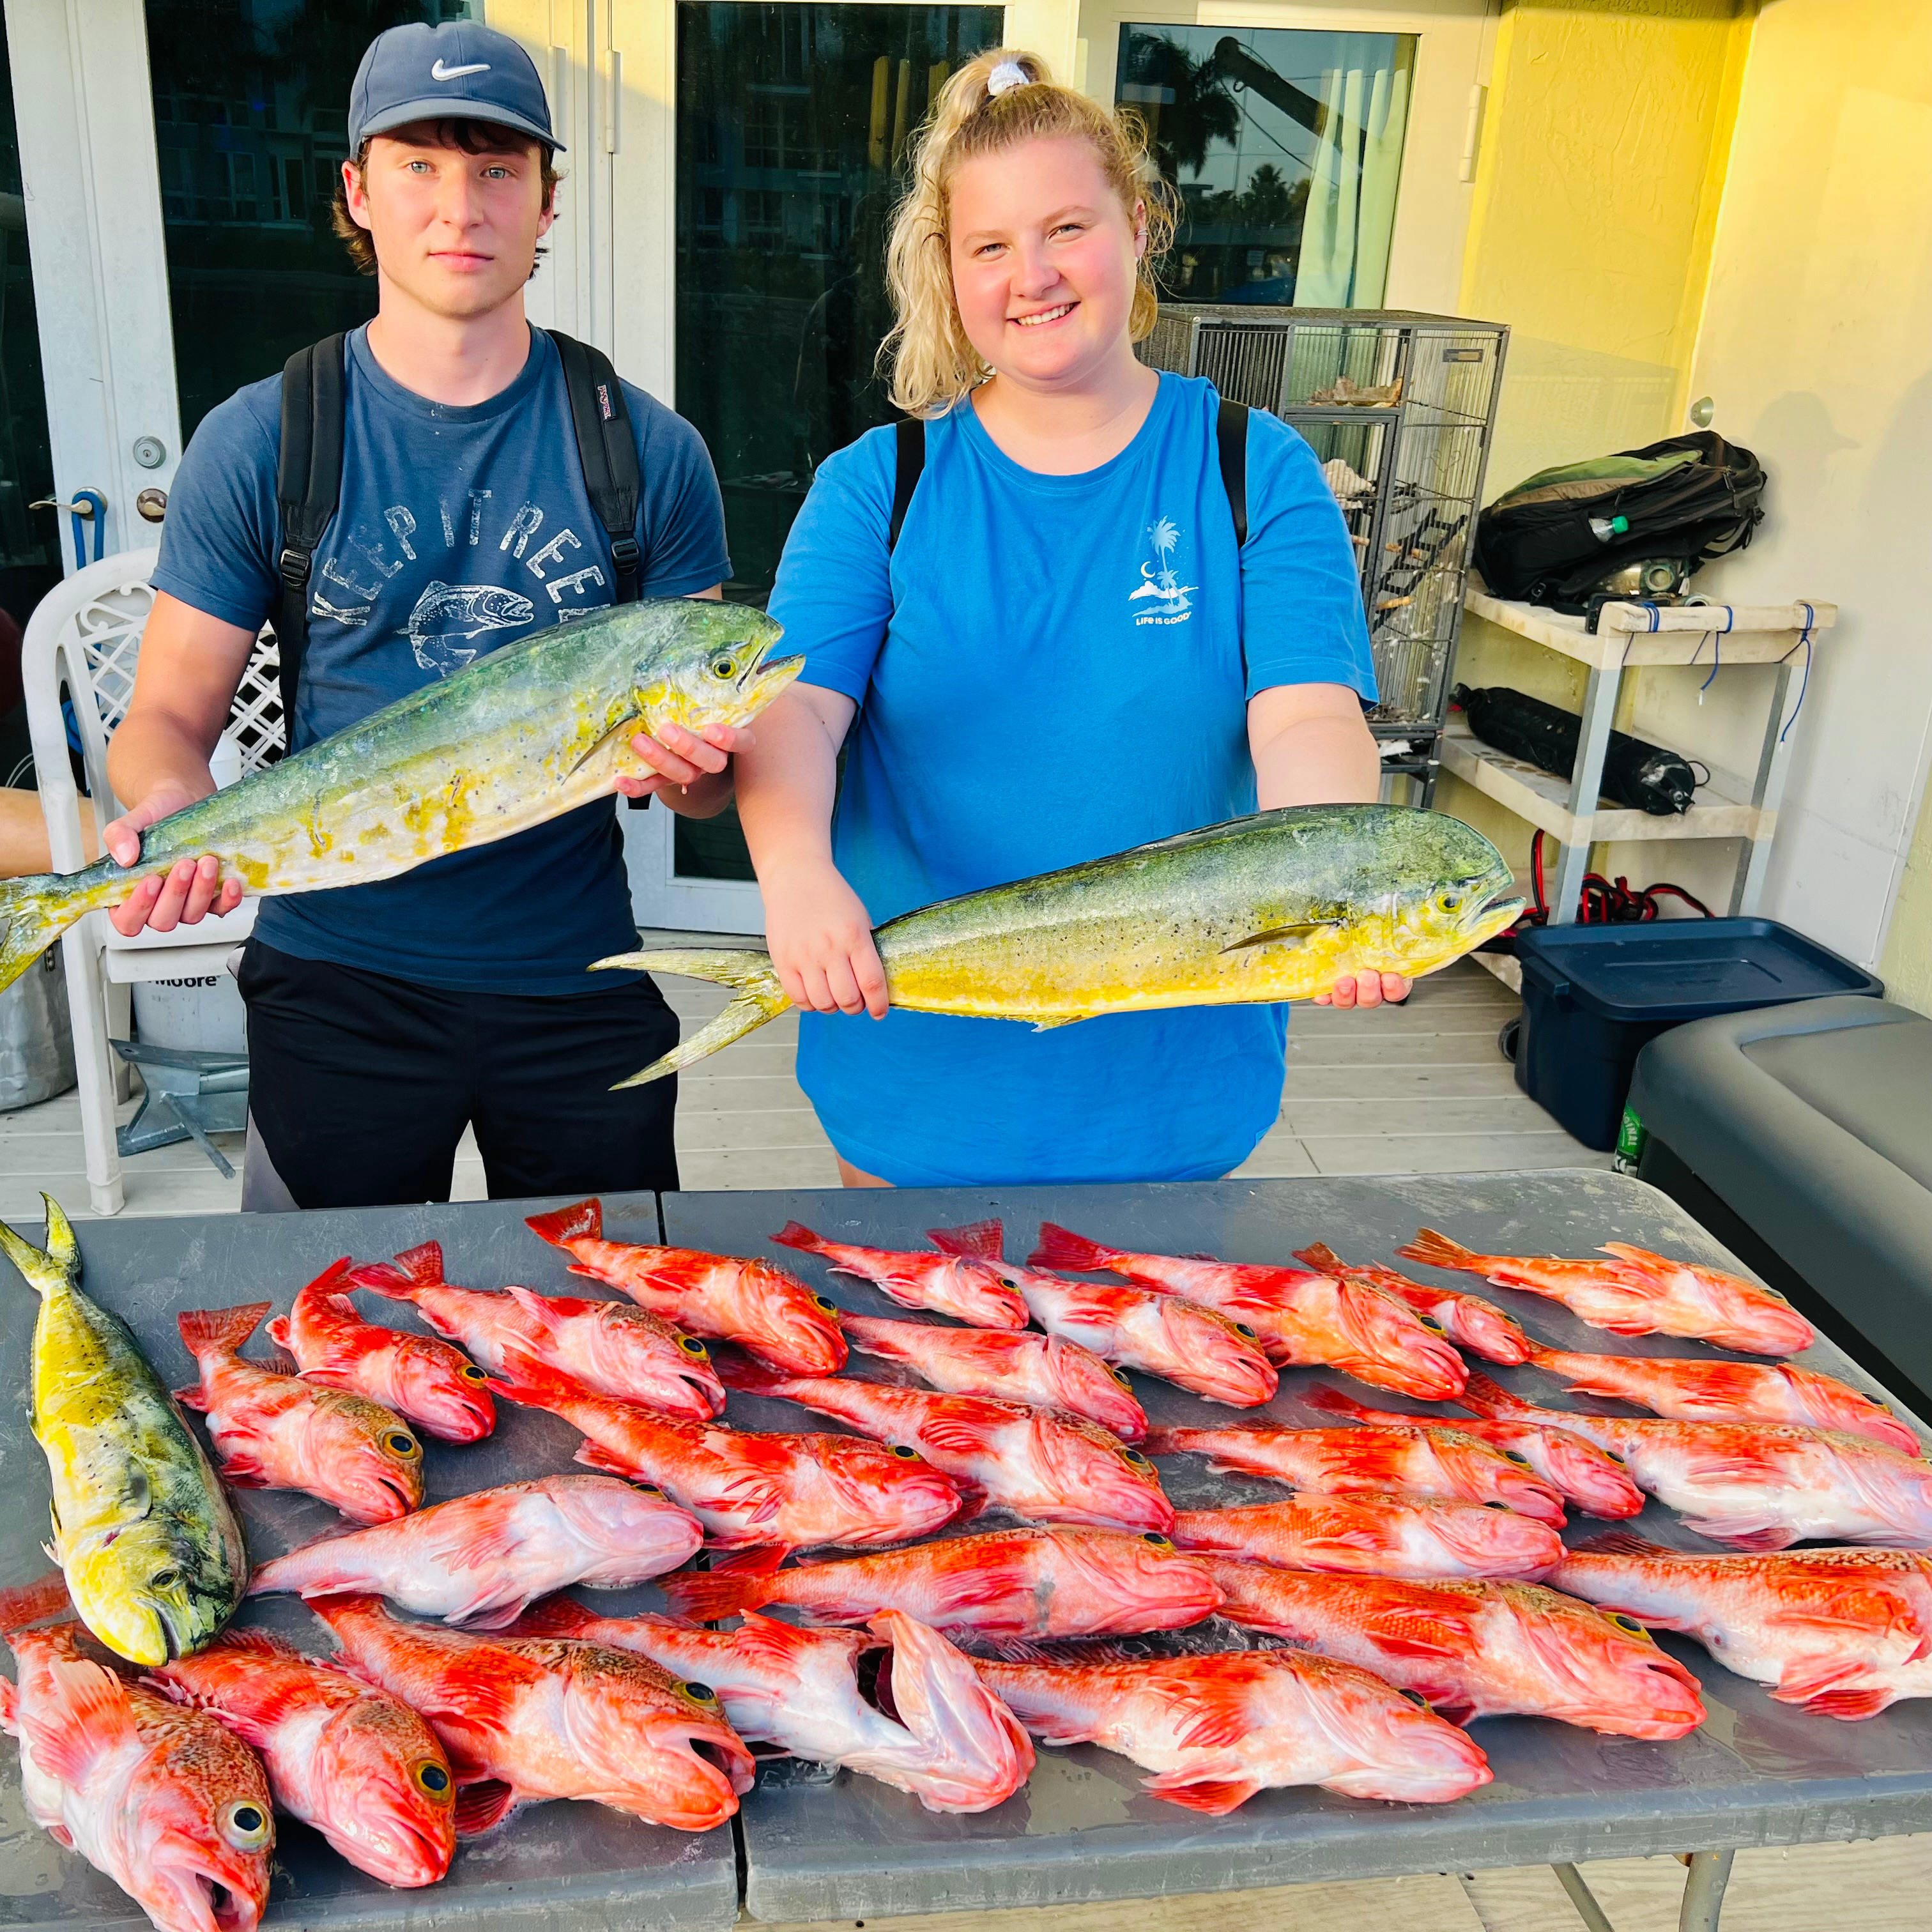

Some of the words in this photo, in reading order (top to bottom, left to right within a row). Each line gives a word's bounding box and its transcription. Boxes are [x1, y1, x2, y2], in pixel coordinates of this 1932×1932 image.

[312, 505, 417, 626] KEEP
[440, 489, 492, 548] IT
[1163, 613, 1190, 625] GOOD
